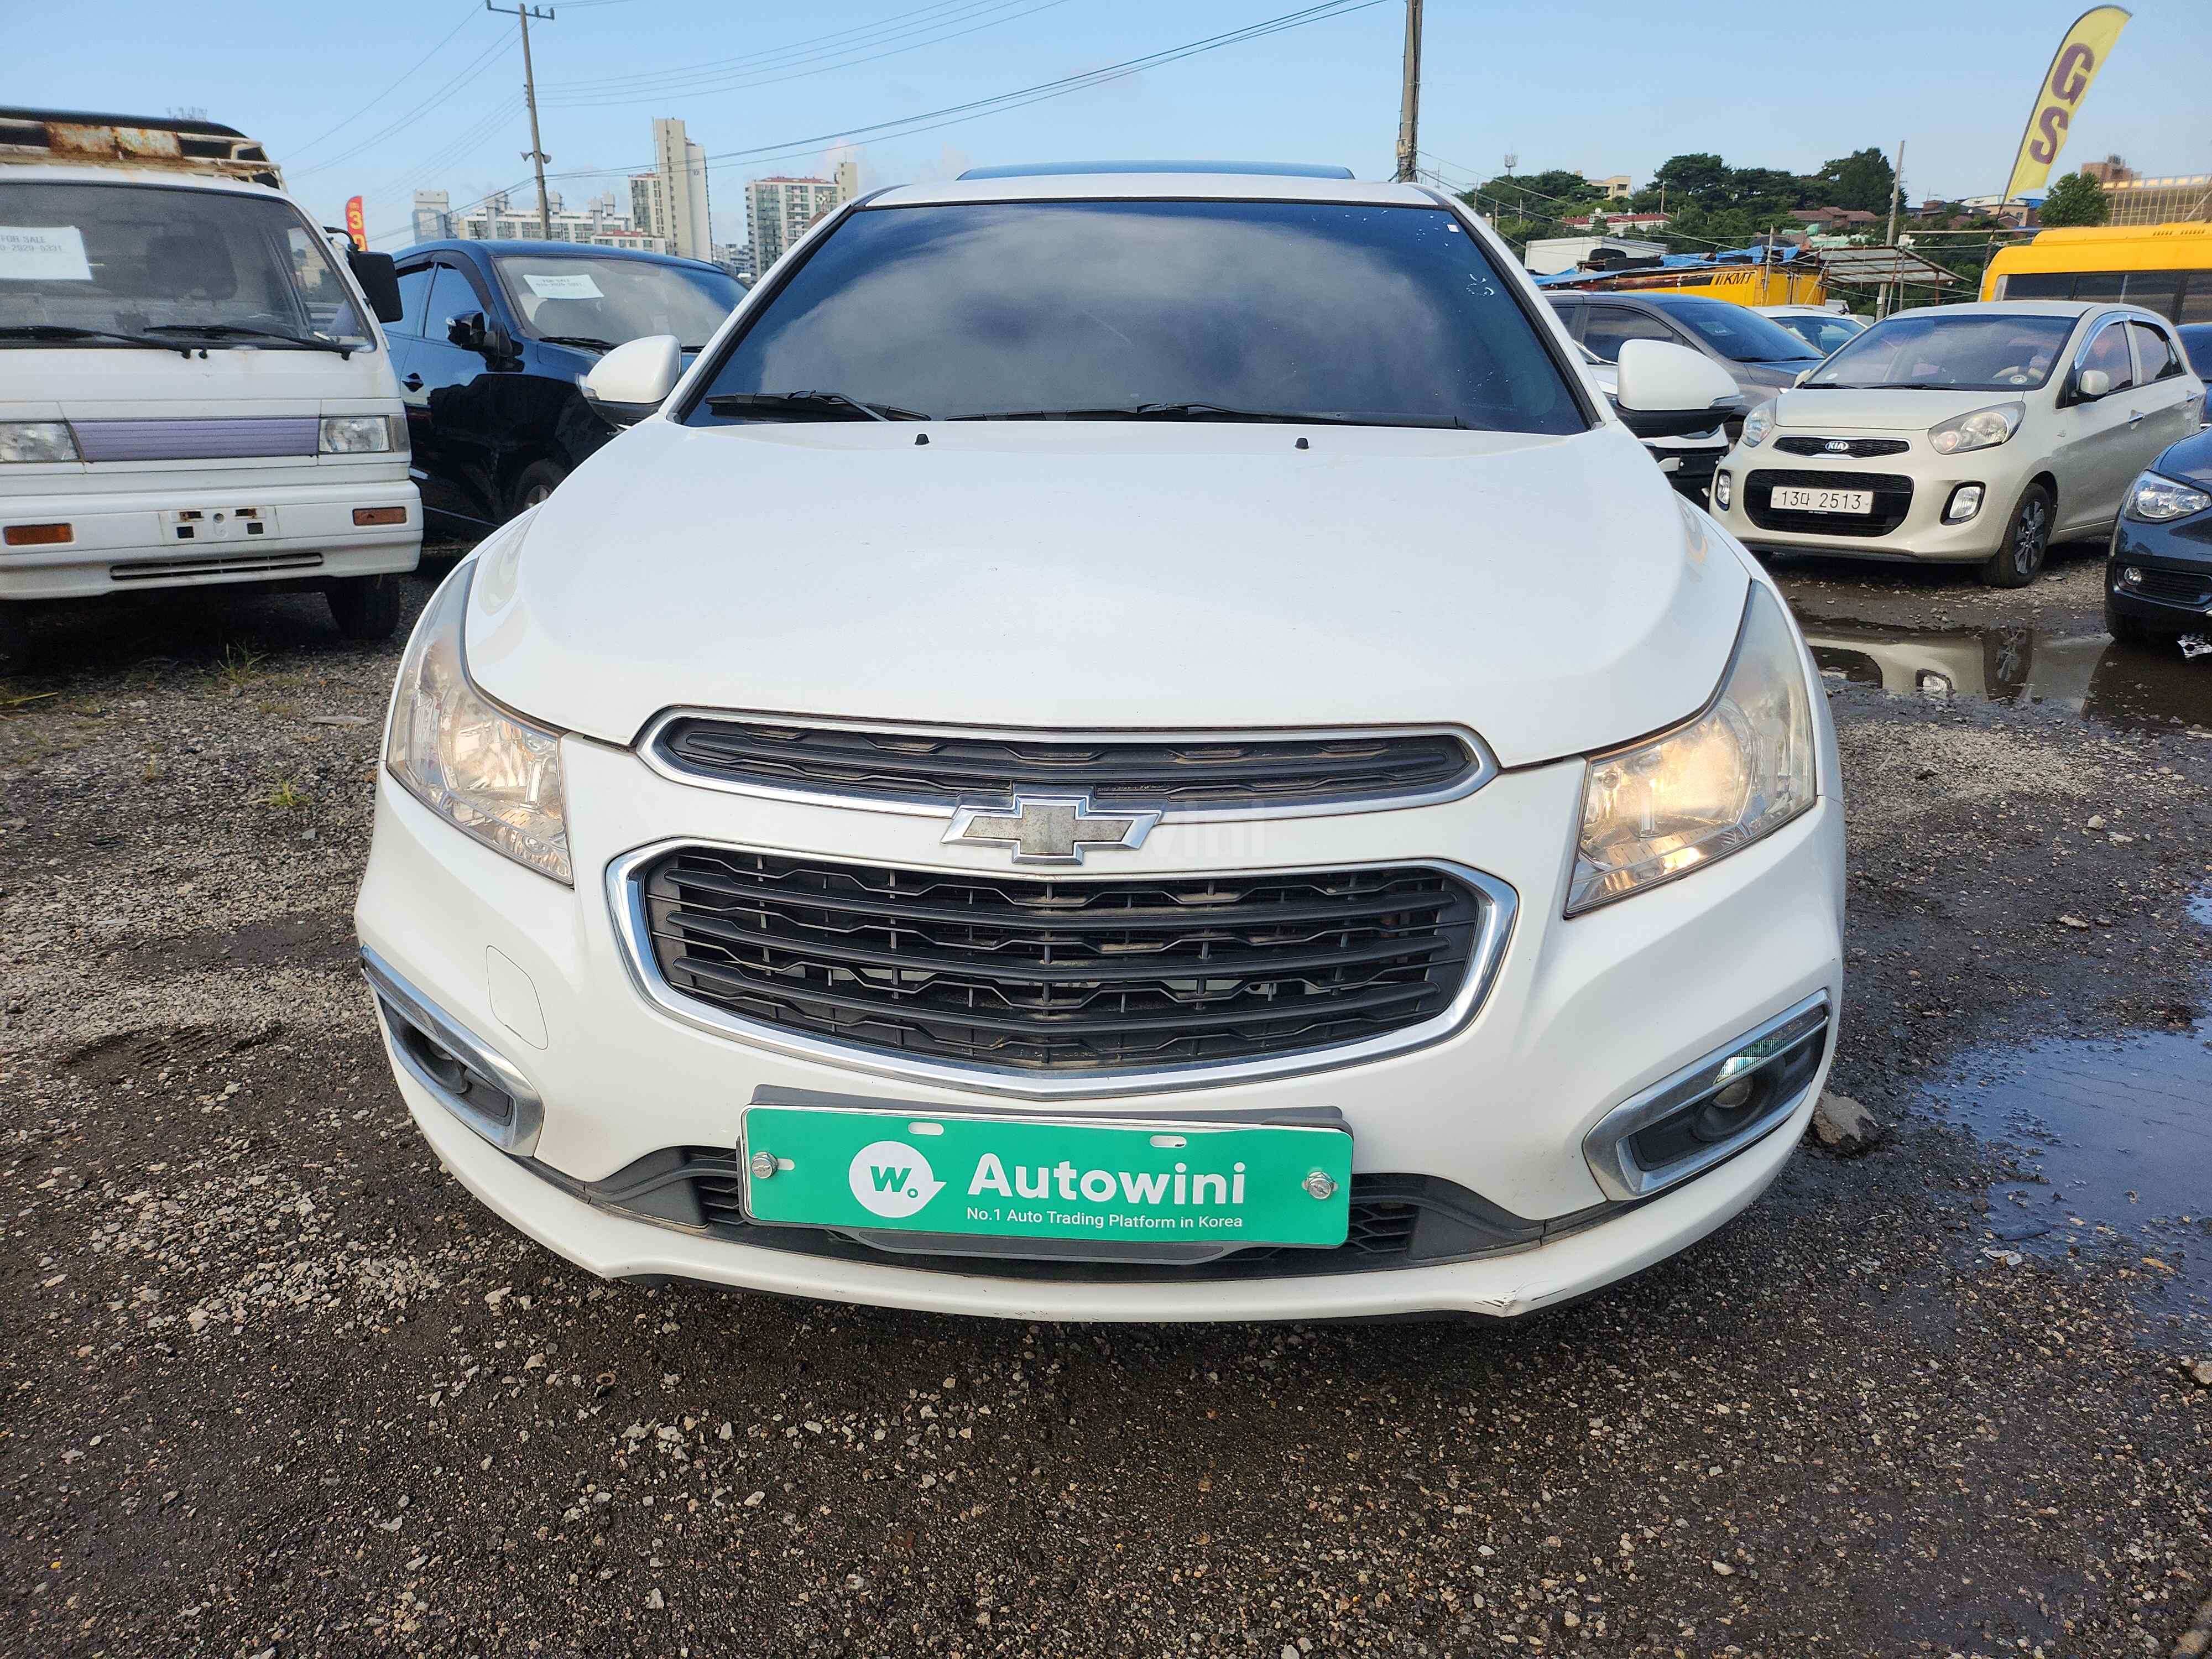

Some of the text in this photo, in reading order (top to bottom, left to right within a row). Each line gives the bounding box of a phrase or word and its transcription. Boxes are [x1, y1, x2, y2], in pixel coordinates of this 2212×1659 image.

[1819, 493, 1862, 509] 2513
[967, 1153, 1245, 1204] Autowini
[967, 1207, 1243, 1229] No.1 Auto Trading Platform in Korea
